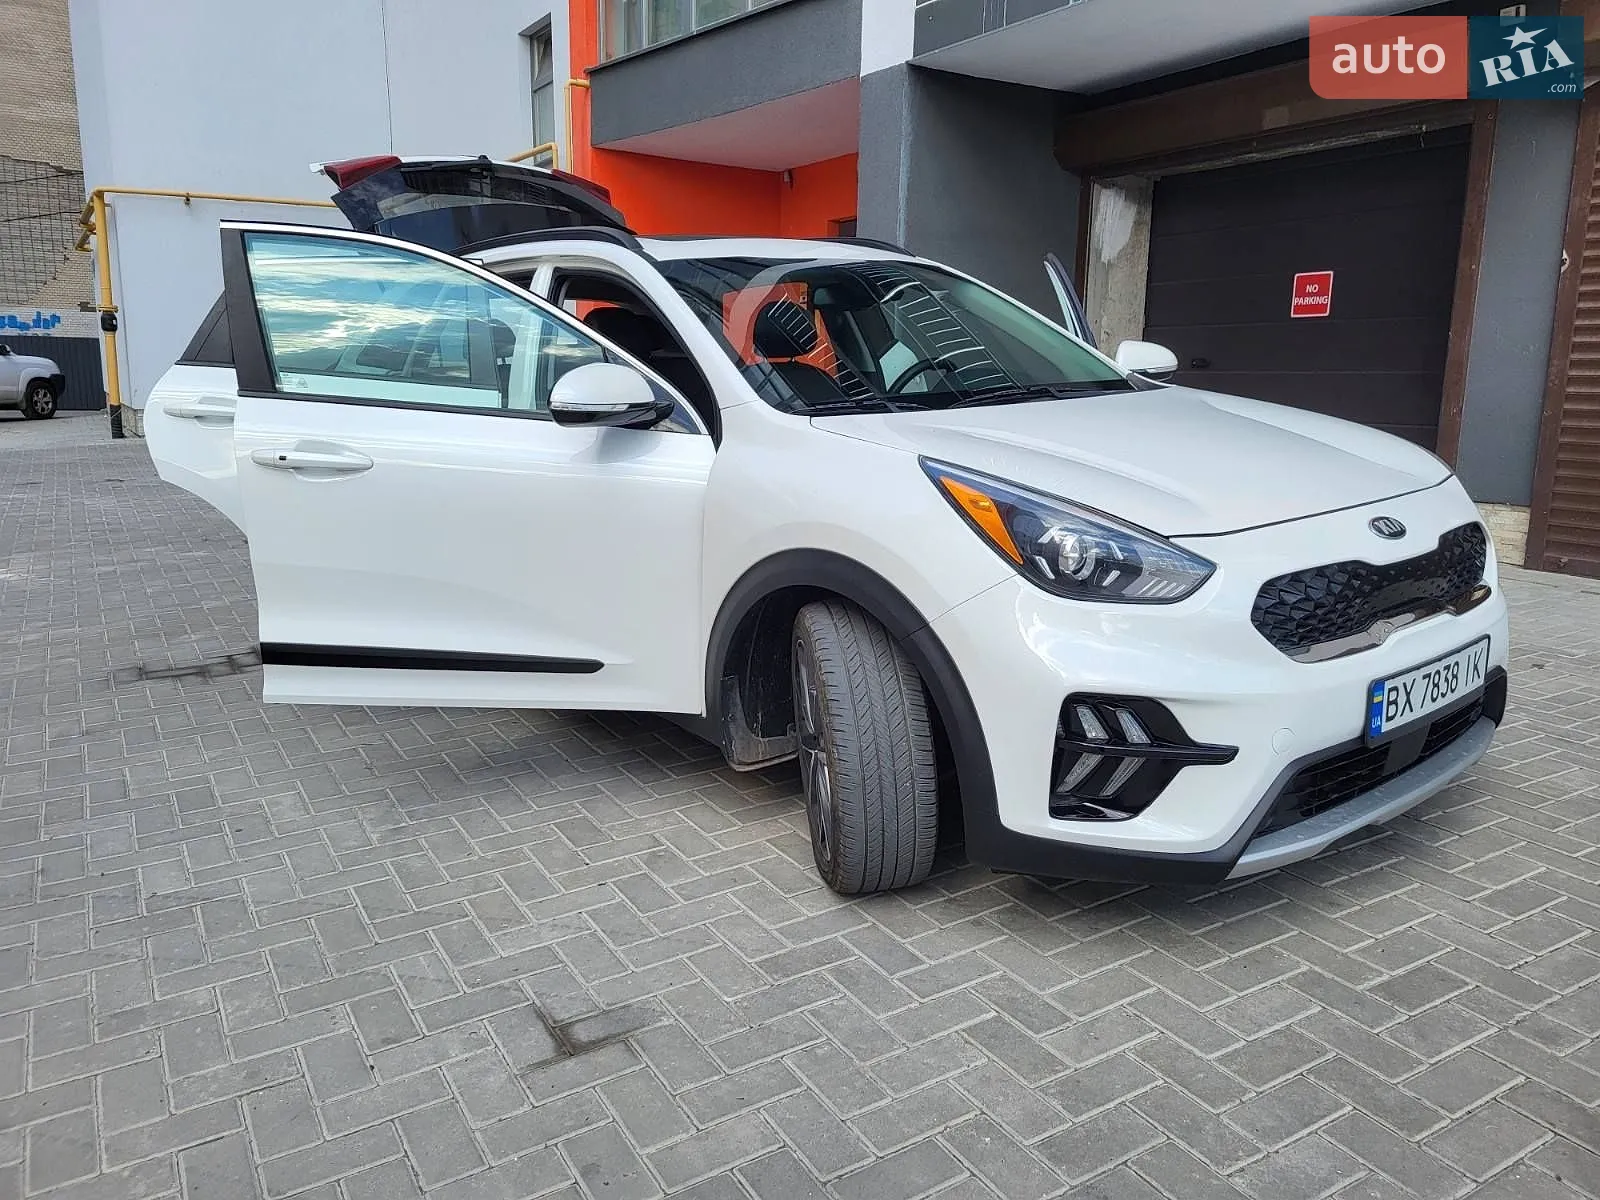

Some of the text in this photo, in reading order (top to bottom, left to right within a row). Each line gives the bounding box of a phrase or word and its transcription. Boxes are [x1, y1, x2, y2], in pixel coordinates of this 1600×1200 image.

[1305, 283, 1319, 293] NO
[1294, 295, 1329, 306] PARKING
[1385, 647, 1483, 723] BX 7838 IK
[1371, 716, 1381, 729] UA
